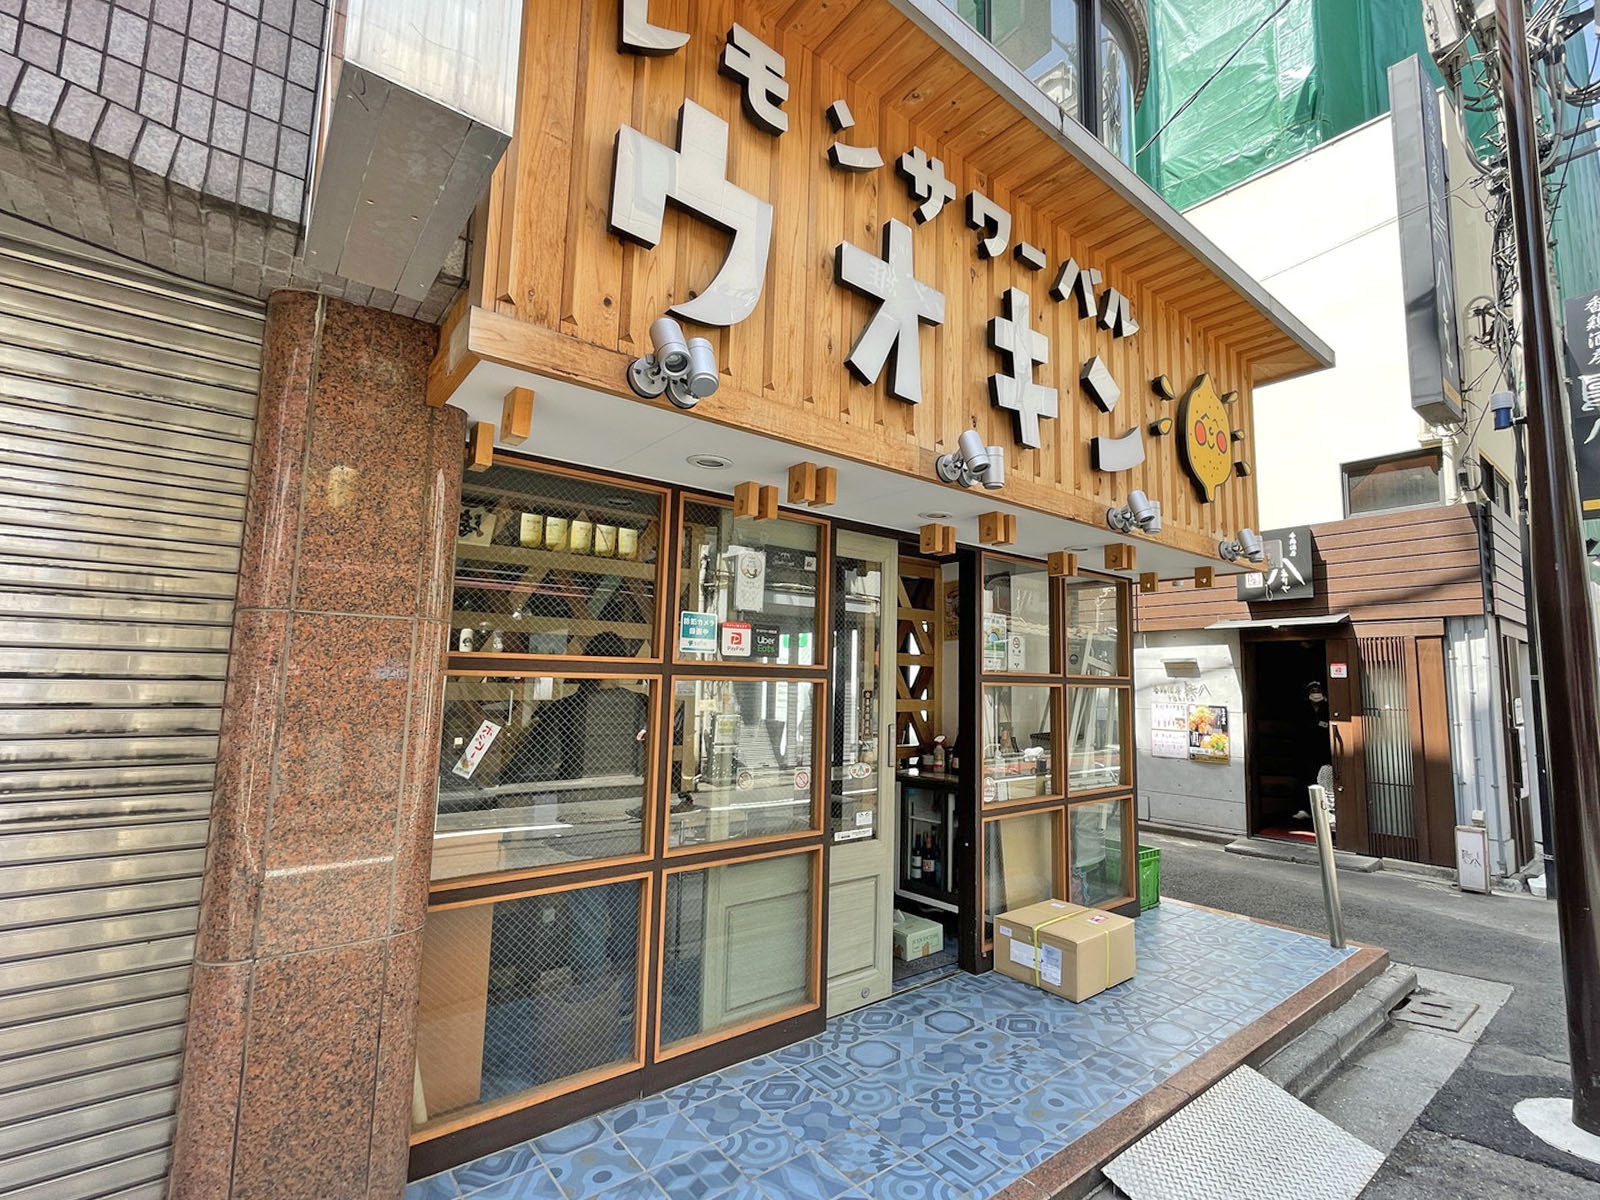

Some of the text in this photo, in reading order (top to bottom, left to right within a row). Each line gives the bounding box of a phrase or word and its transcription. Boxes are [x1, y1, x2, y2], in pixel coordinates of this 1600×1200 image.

[608, 98, 1145, 472] ウオキン
[757, 636, 775, 644] Uber
[757, 645, 775, 653] Eats
